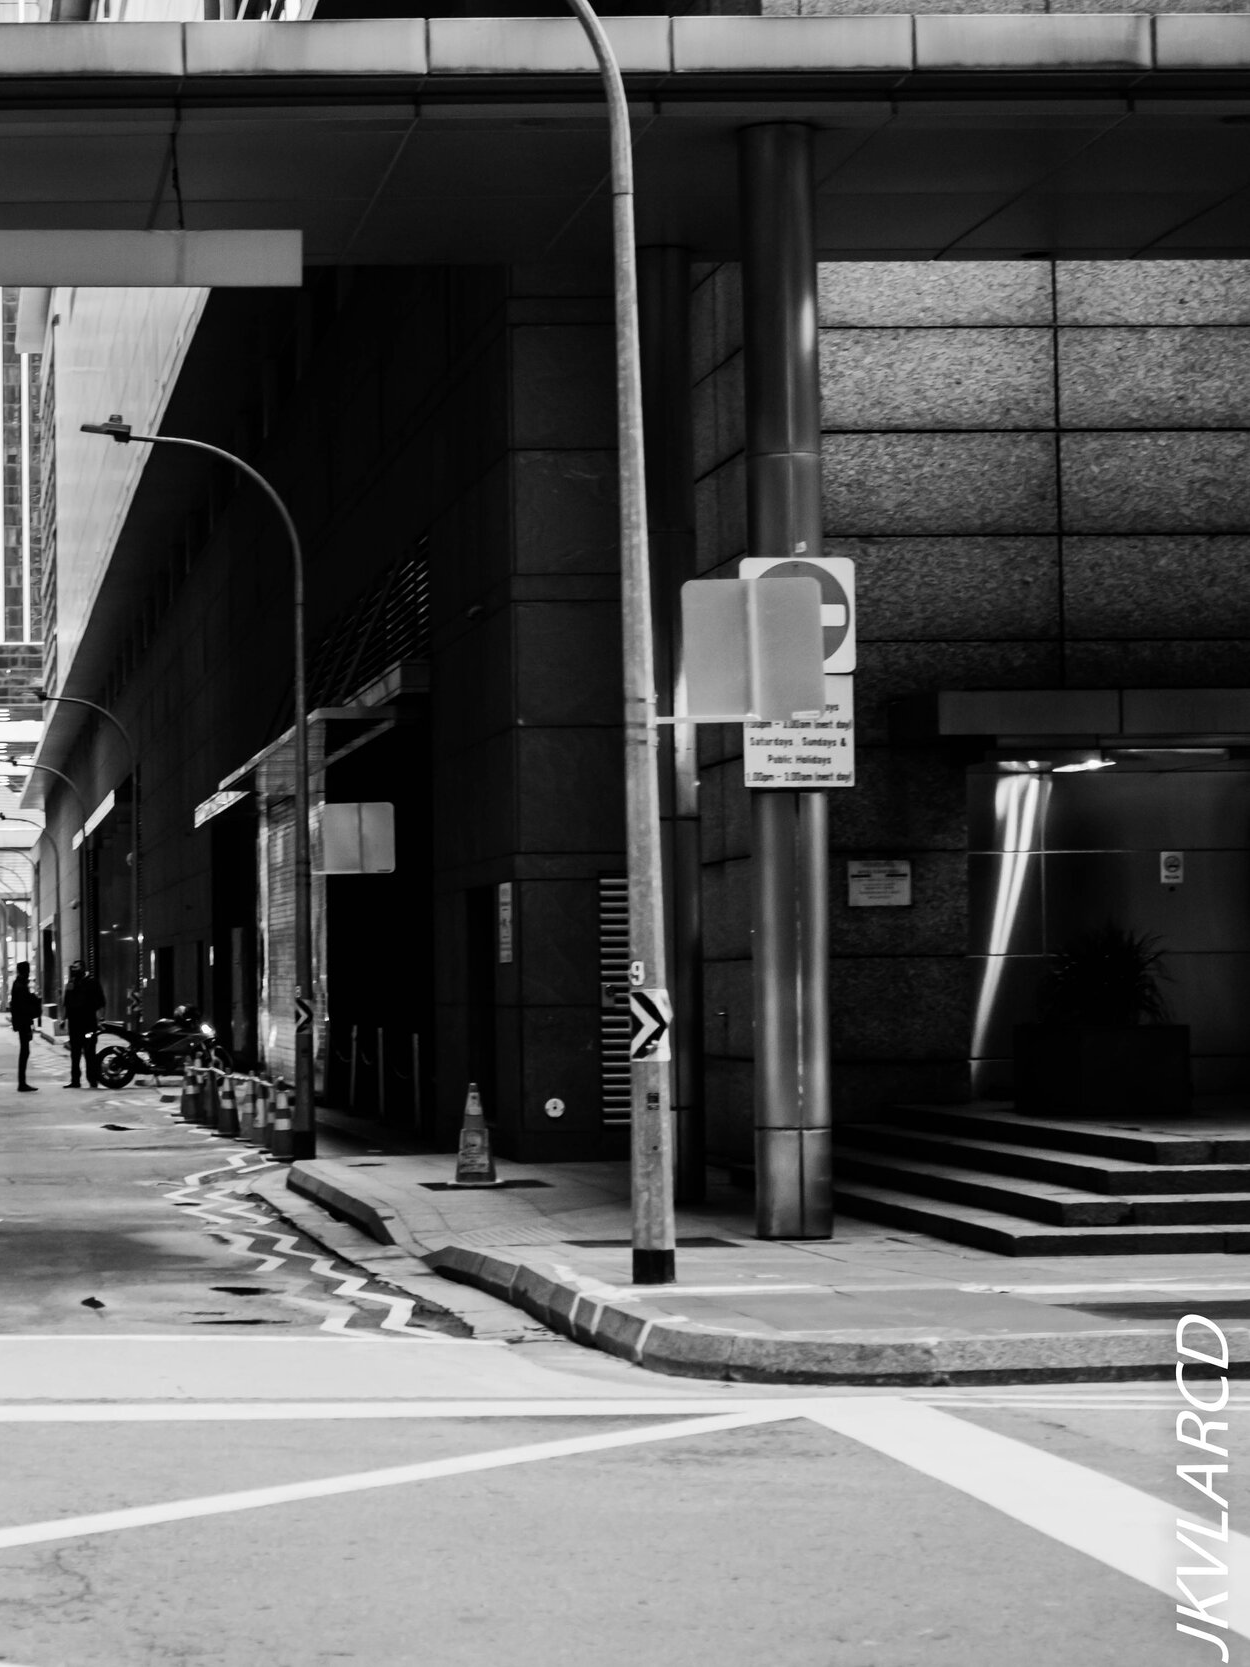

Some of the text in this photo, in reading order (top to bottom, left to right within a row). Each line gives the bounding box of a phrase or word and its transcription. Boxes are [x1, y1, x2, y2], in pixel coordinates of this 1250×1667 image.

[802, 737, 836, 749] Sundays
[767, 754, 831, 766] Public Holidays
